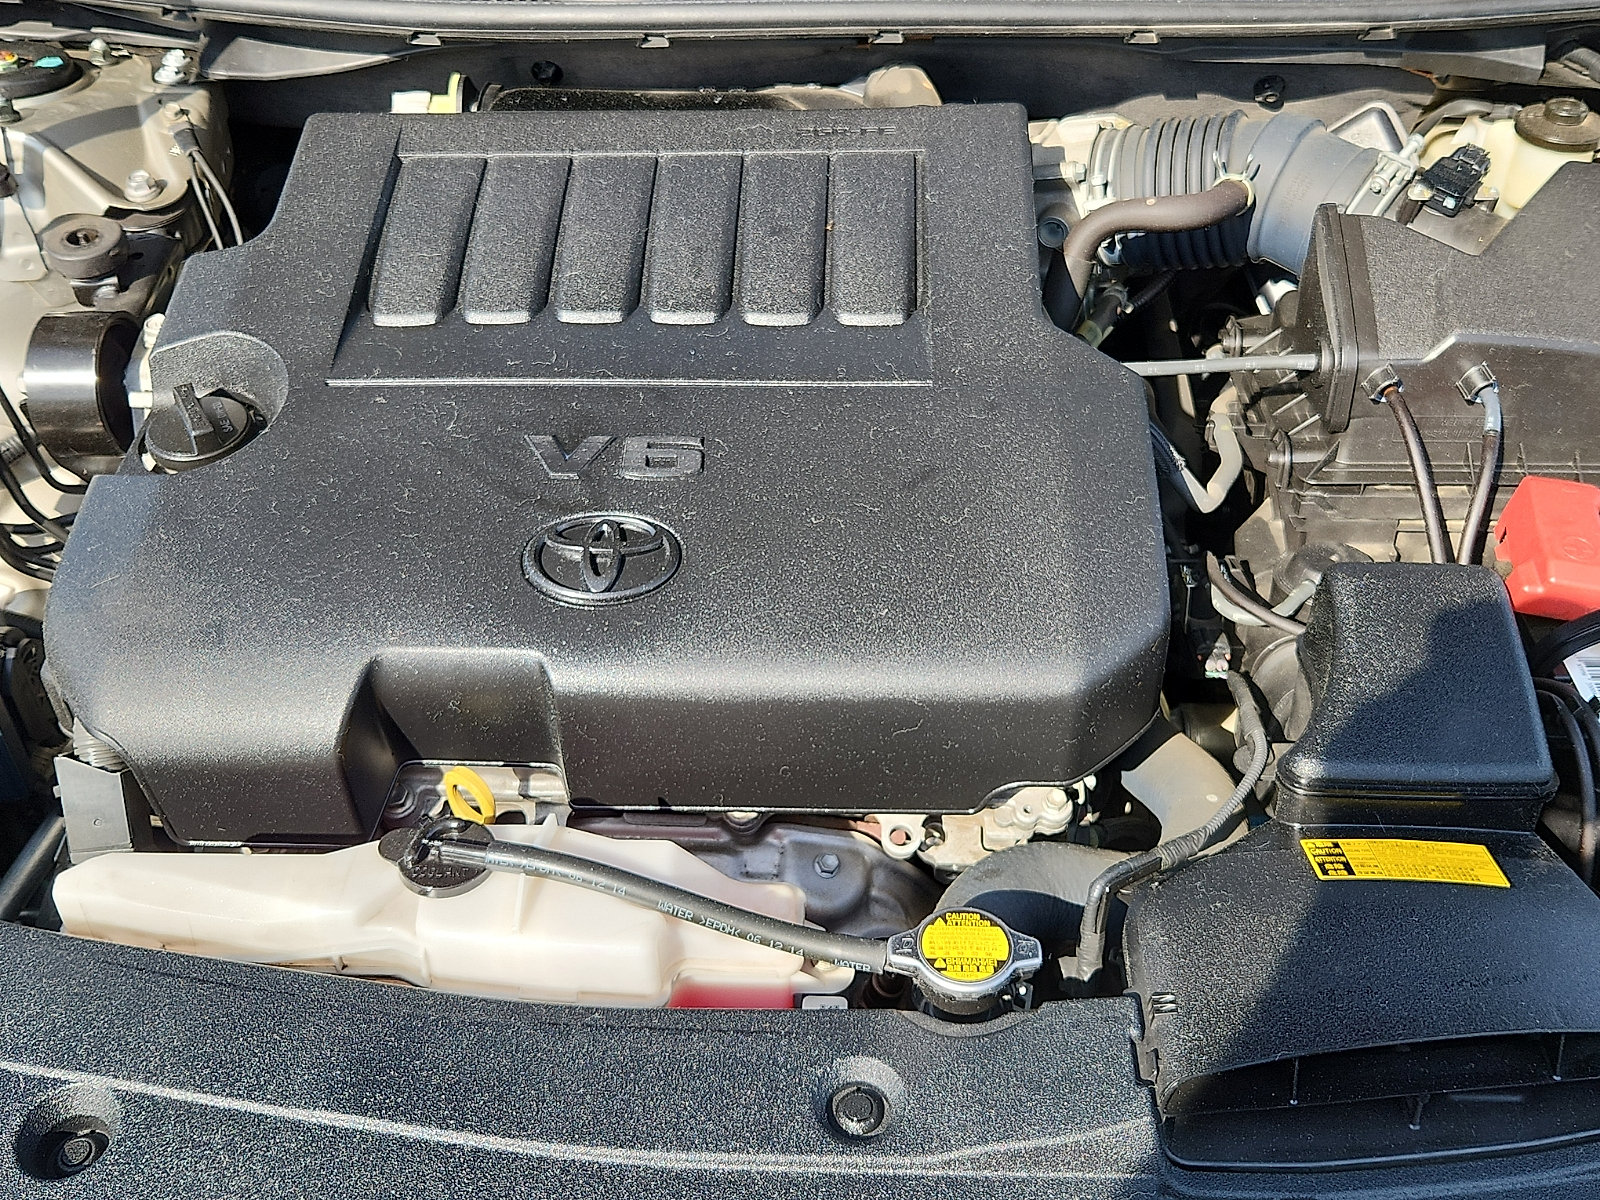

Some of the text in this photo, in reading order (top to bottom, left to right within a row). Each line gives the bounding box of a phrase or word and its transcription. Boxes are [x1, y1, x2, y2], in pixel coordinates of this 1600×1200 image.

[523, 434, 706, 480] V6
[1310, 847, 1344, 856] CAUTION
[592, 879, 606, 890] 12
[613, 885, 627, 897] 14
[945, 912, 980, 920] CAUTION
[657, 898, 694, 921] WATER
[699, 914, 742, 938] >EPDM<
[746, 931, 762, 944] 06
[790, 946, 804, 956] 14
[946, 919, 991, 927] ATTENTION
[834, 959, 871, 972] WATER
